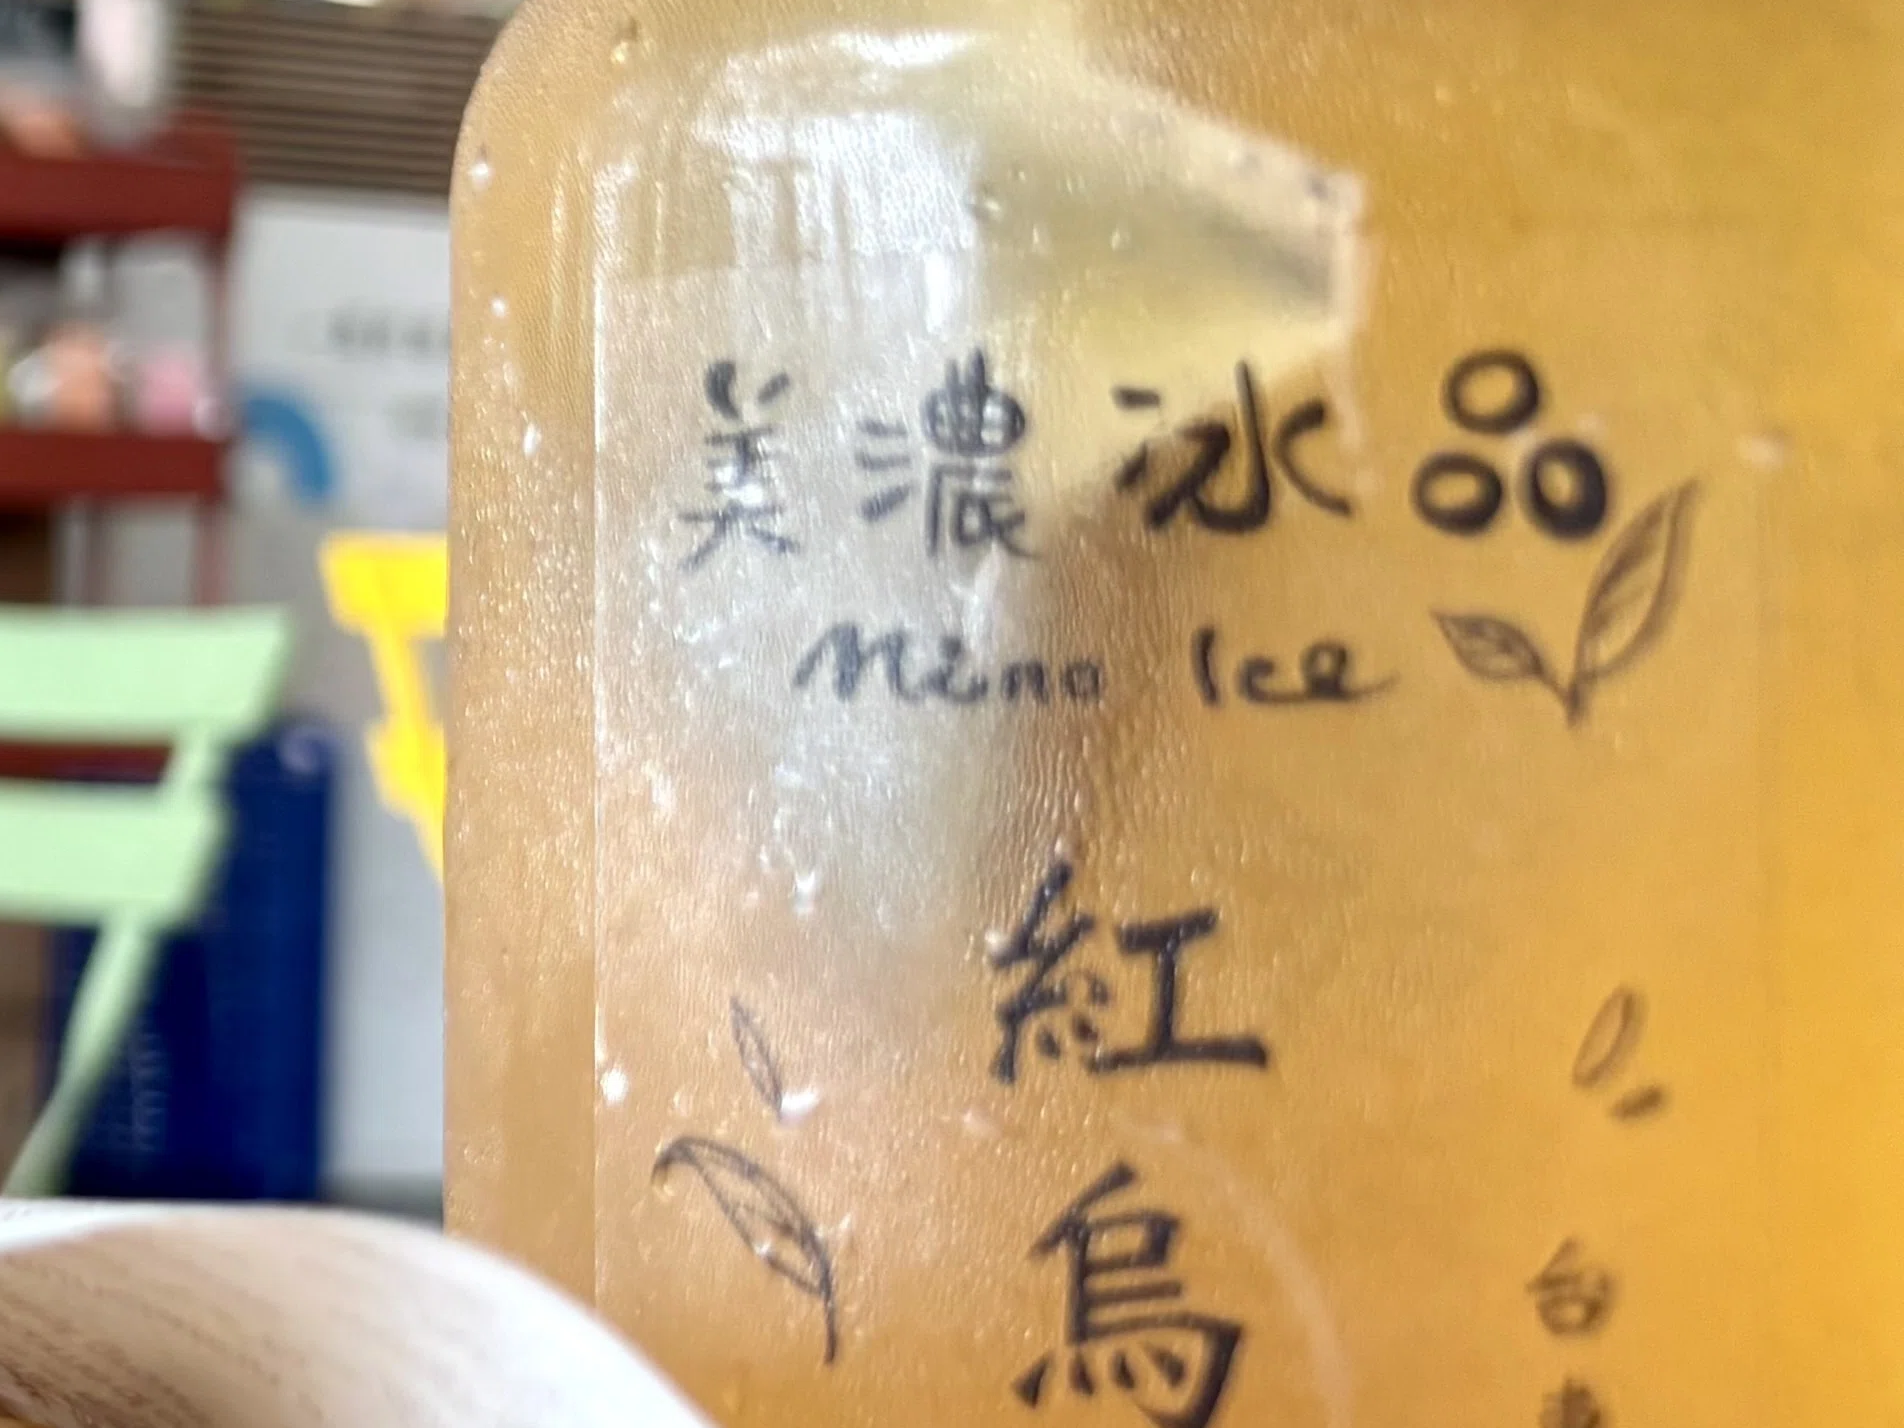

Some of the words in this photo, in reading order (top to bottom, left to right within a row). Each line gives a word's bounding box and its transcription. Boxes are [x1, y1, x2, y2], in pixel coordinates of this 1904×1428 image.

[676, 346, 1612, 572] 美濃冰品
[1190, 624, 1398, 710] Ice
